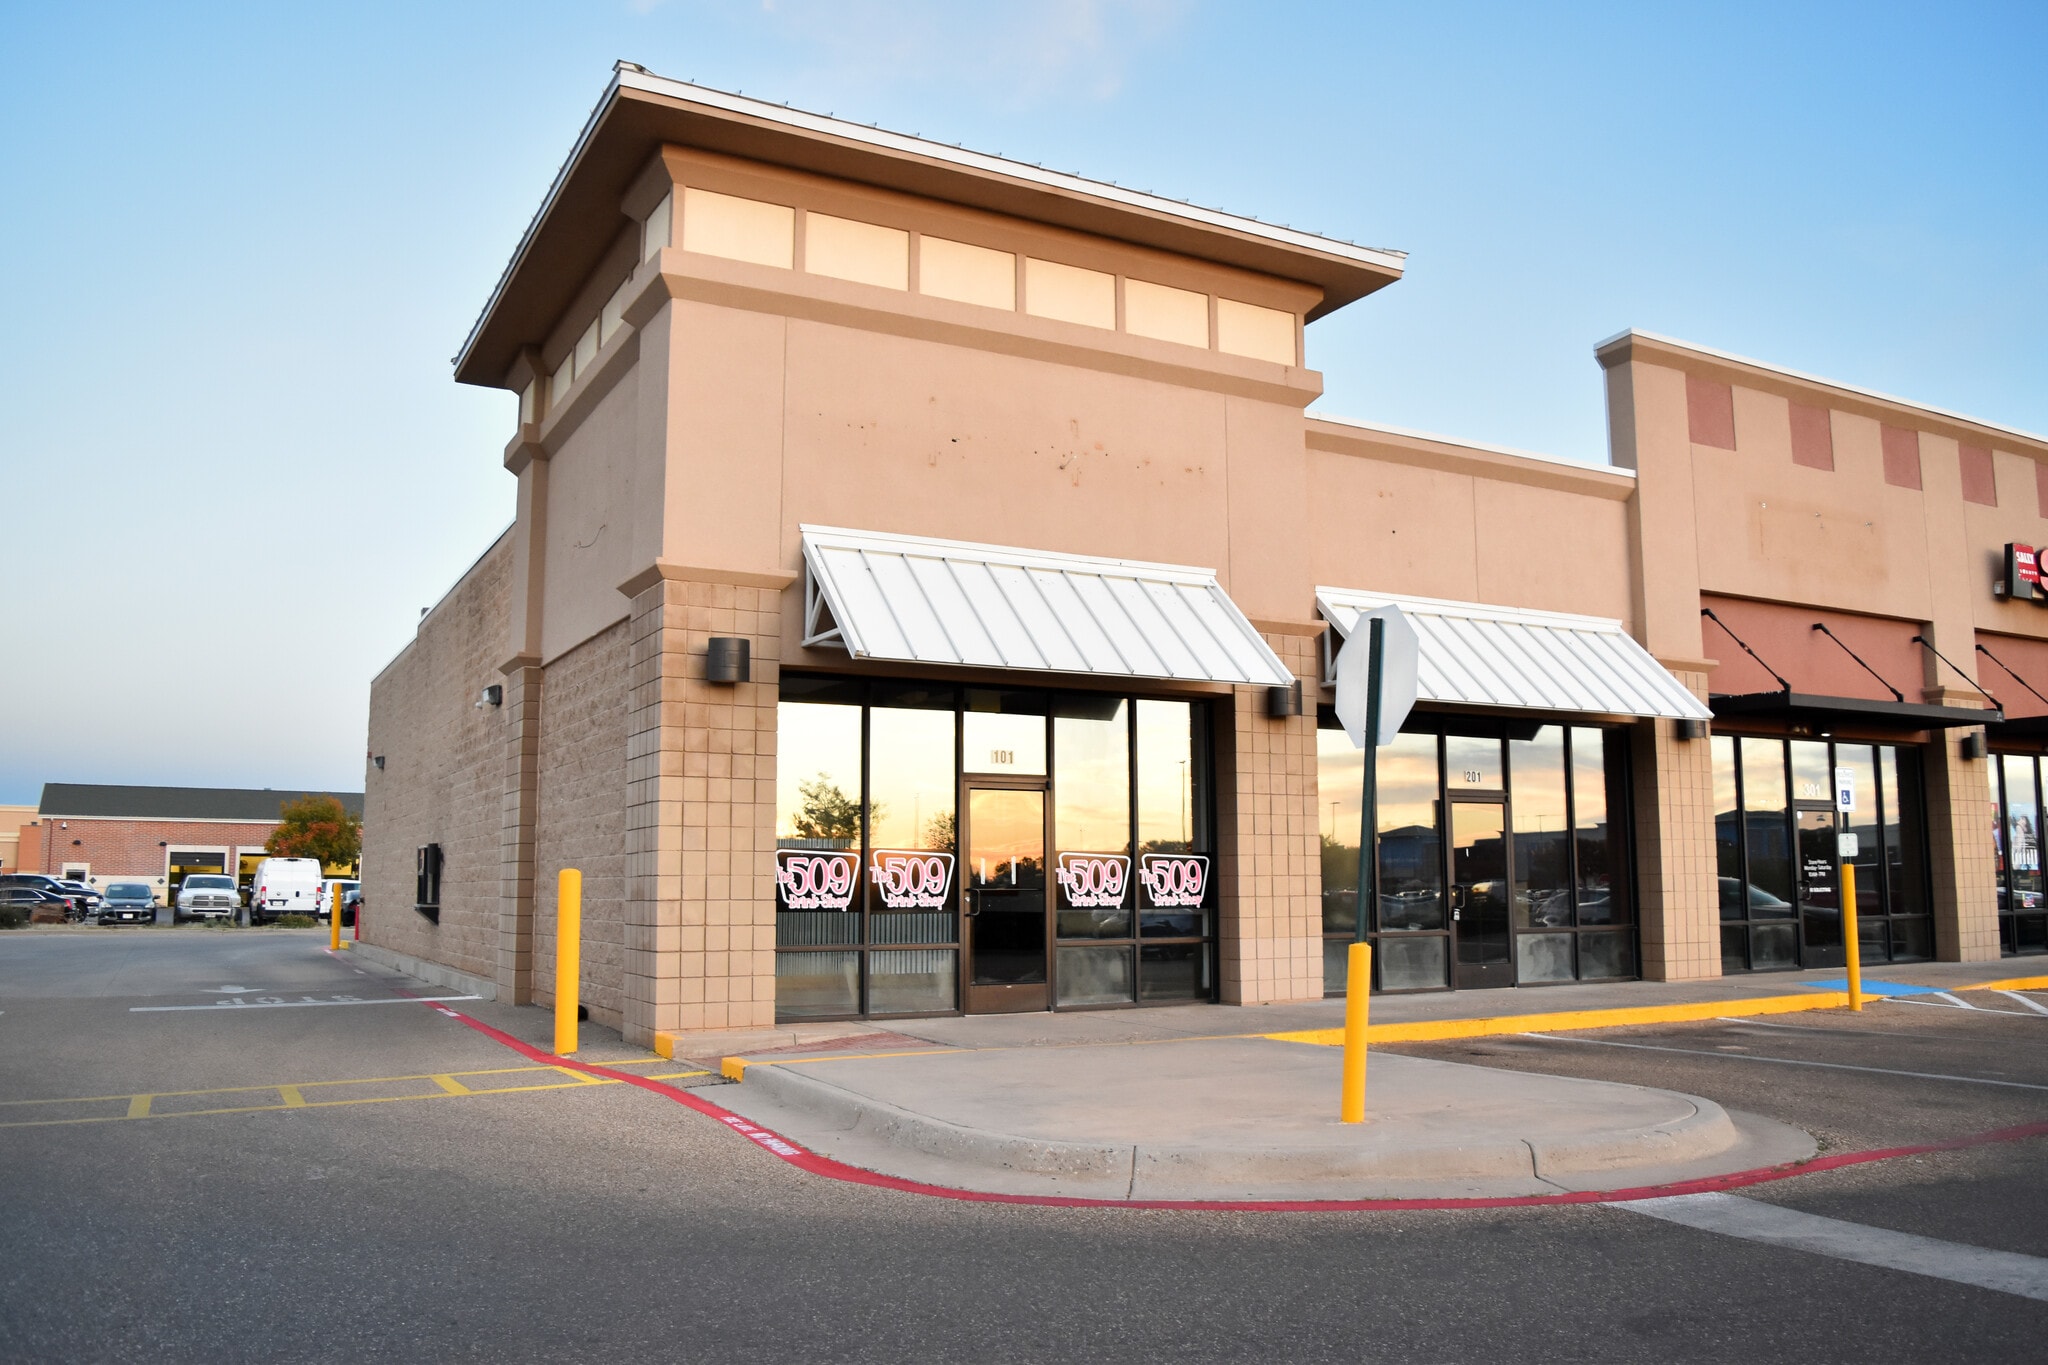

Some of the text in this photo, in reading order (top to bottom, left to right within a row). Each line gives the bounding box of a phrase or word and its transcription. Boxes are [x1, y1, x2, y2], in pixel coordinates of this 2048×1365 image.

[994, 749, 1013, 764] 101
[1466, 771, 1481, 783] 201
[1804, 783, 1821, 797] 301
[787, 857, 850, 896] 509
[869, 857, 946, 895] The 509
[1055, 859, 1123, 895] The 509
[1139, 860, 1203, 895] The 509
